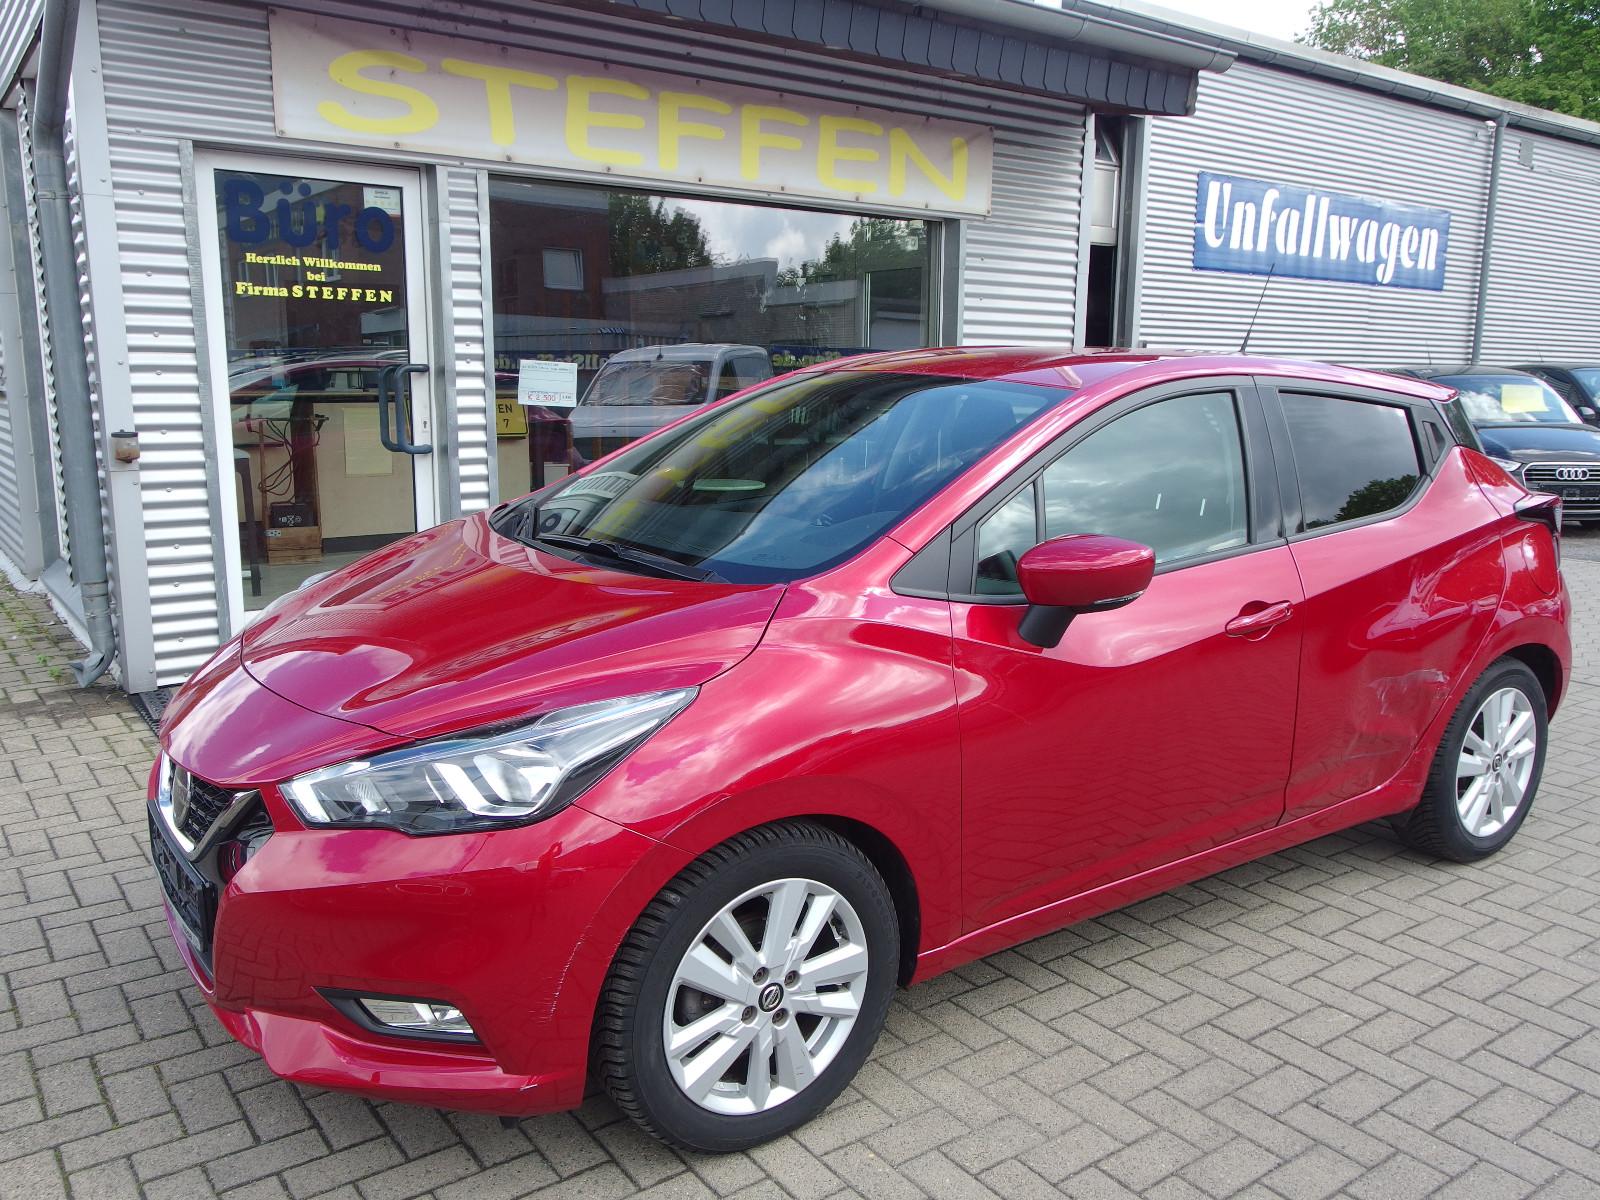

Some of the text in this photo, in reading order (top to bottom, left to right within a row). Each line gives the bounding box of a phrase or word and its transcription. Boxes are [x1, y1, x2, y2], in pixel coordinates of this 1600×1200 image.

[316, 49, 969, 200] STEFFEN
[224, 179, 394, 253] Büro
[1204, 181, 1439, 284] Unfallwagen
[245, 252, 382, 272] Herzlich Willkommen
[306, 271, 326, 282] bei
[235, 282, 393, 303] Firma STEFFEN
[496, 403, 513, 414] EN
